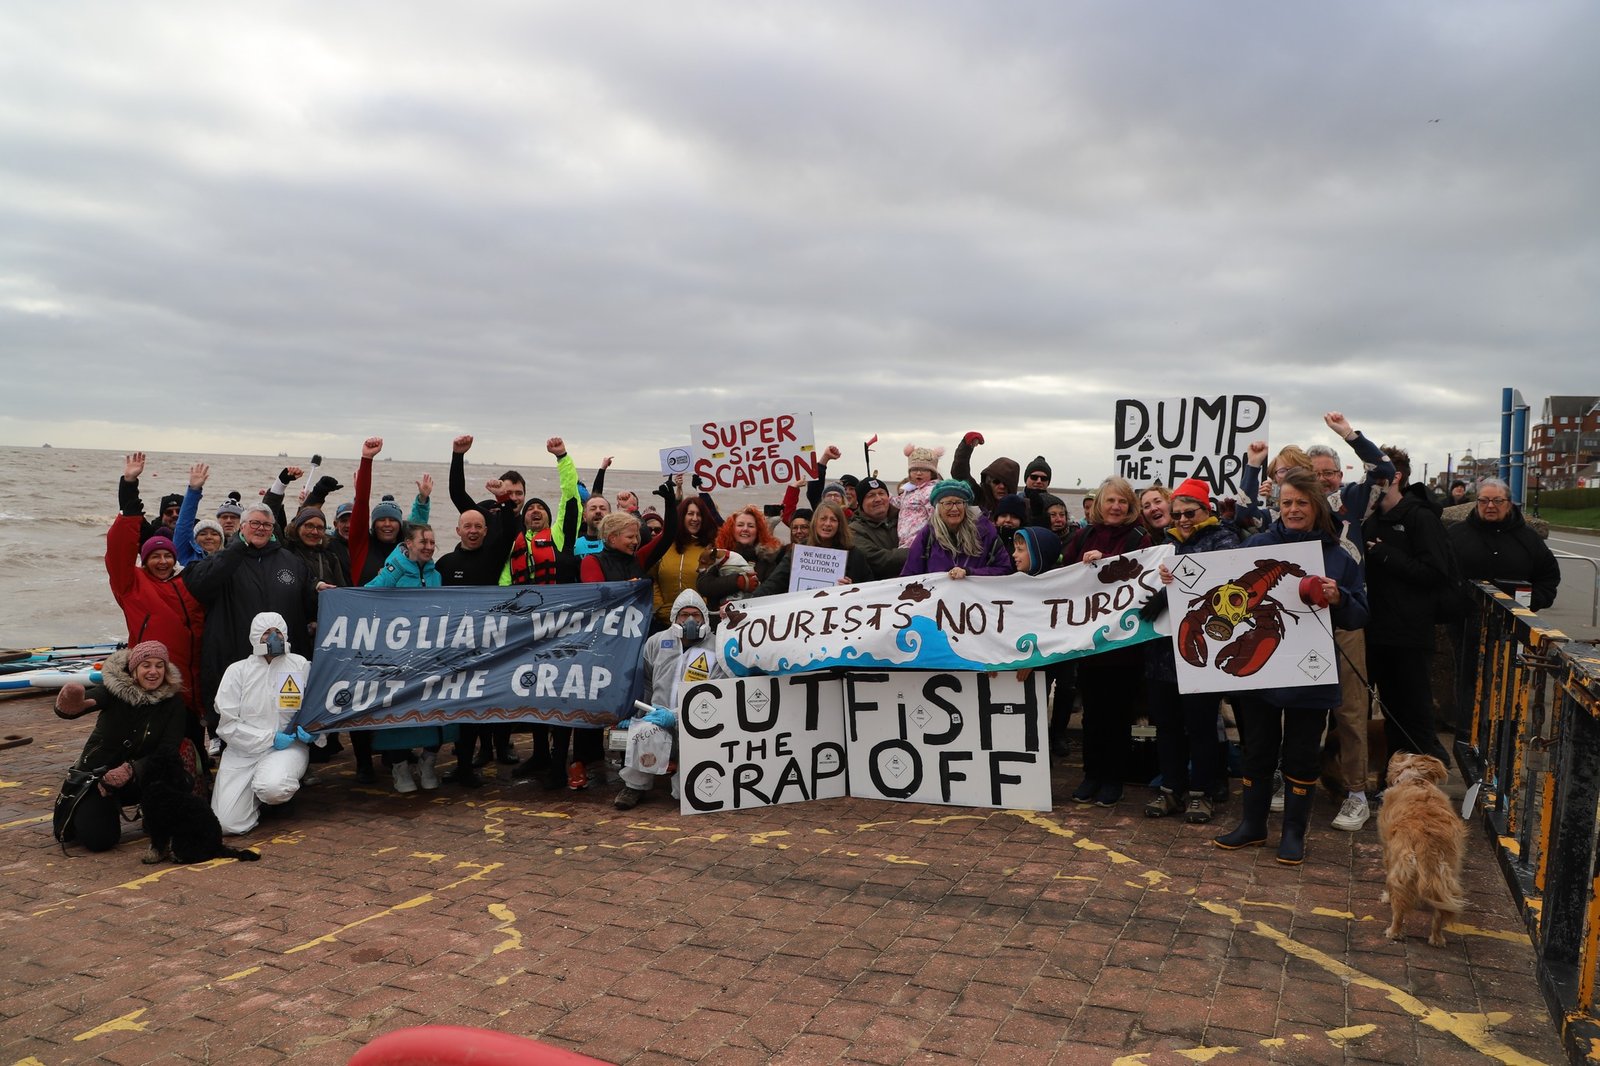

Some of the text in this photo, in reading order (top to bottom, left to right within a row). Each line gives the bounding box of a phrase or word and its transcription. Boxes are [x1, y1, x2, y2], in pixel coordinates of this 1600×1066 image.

[702, 414, 797, 449] SUPER
[1115, 395, 1267, 455] DUMP
[694, 451, 819, 492] SCAMON
[729, 444, 780, 465] SIZE
[1117, 454, 1152, 480] THE
[799, 557, 830, 566] SOLUTION
[800, 565, 835, 574] POLLUTION
[815, 552, 831, 560] NEED
[321, 605, 645, 650] ANGLIAN WATER
[735, 602, 914, 654] TOURISTS
[936, 598, 1013, 636] NOT
[325, 663, 613, 714] CUT THE CRAP
[682, 672, 844, 738] CUT
[721, 732, 792, 763] THE
[685, 742, 846, 811] CRAP
[869, 739, 1036, 805] OFF
